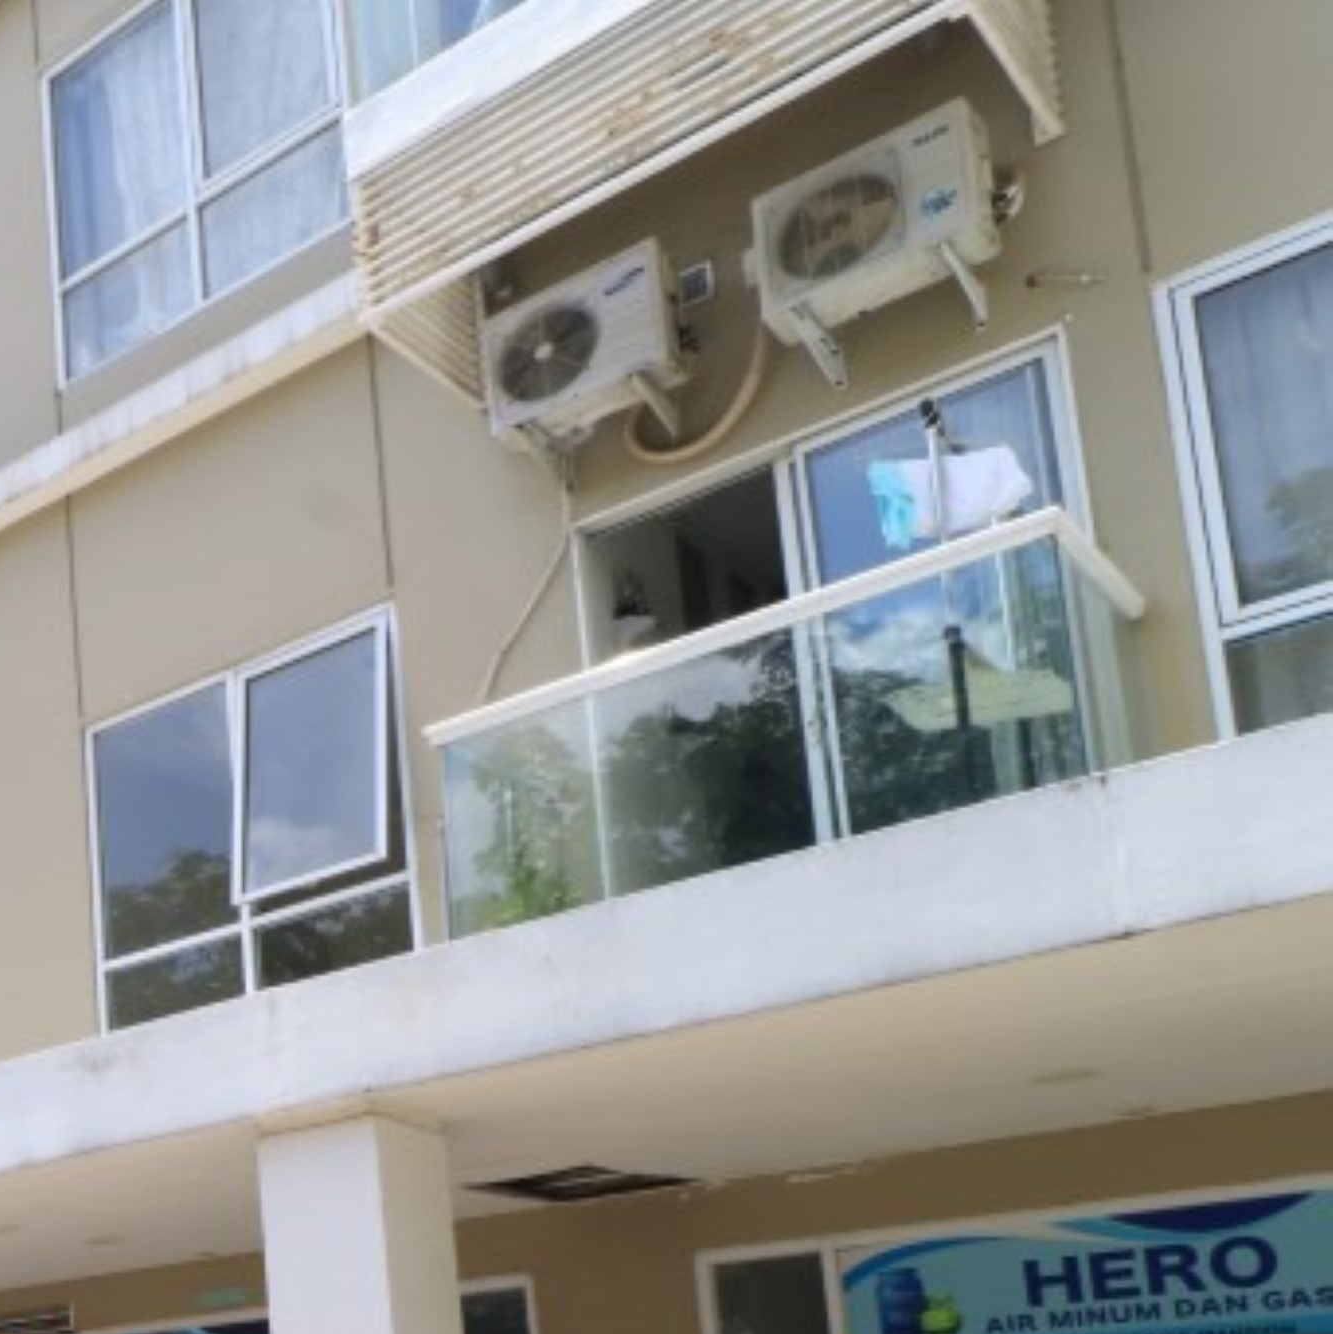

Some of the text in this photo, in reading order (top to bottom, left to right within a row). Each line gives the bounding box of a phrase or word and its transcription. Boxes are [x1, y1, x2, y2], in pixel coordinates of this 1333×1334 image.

[1022, 1236, 1278, 1307] HERO
[1049, 1303, 1162, 1331] MINUM
[1174, 1296, 1248, 1319] DAN
[1262, 1285, 1333, 1309] GAS
